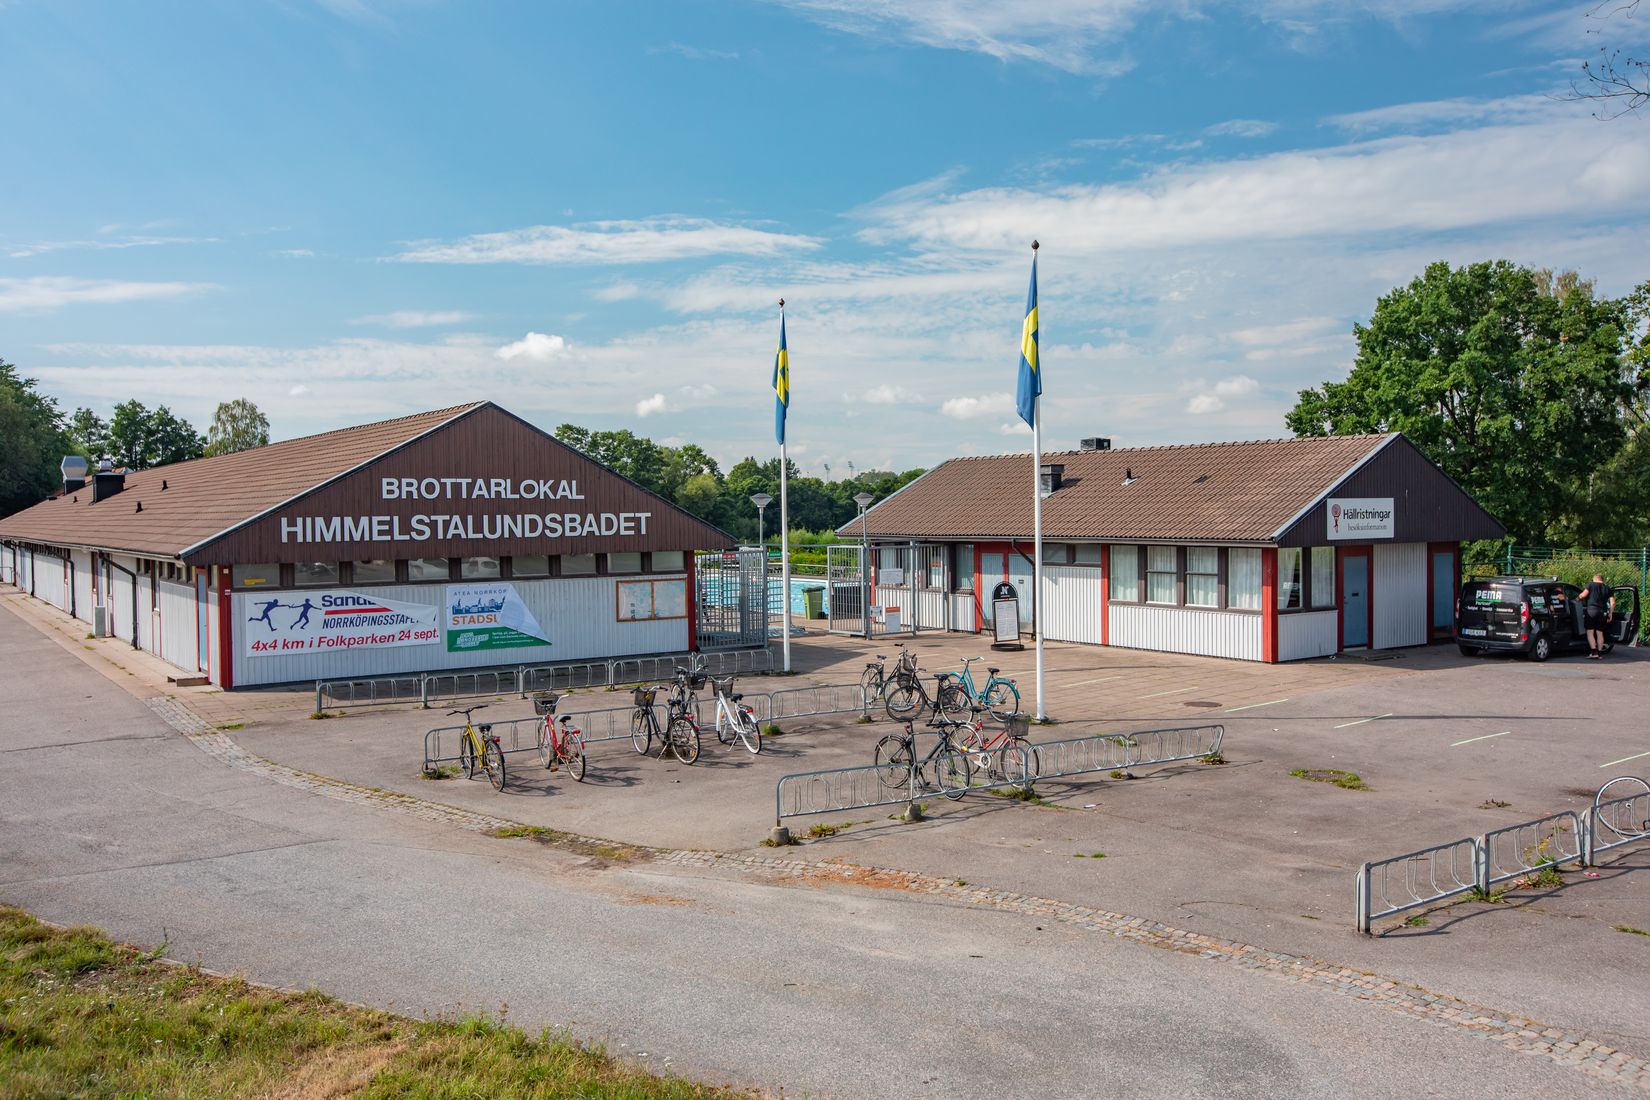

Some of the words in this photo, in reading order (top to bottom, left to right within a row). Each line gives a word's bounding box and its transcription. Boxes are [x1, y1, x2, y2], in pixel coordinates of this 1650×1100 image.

[381, 478, 585, 500] BROTTARLOKAL
[1343, 507, 1392, 522] Hällristningar
[280, 512, 652, 544] HIMMELSTALUNDSBADET
[251, 639, 278, 652] 4x4
[282, 638, 305, 650] km
[308, 636, 314, 649] i
[317, 633, 396, 648] Folkparken
[399, 630, 411, 641] 24
[413, 628, 440, 641] sept.
